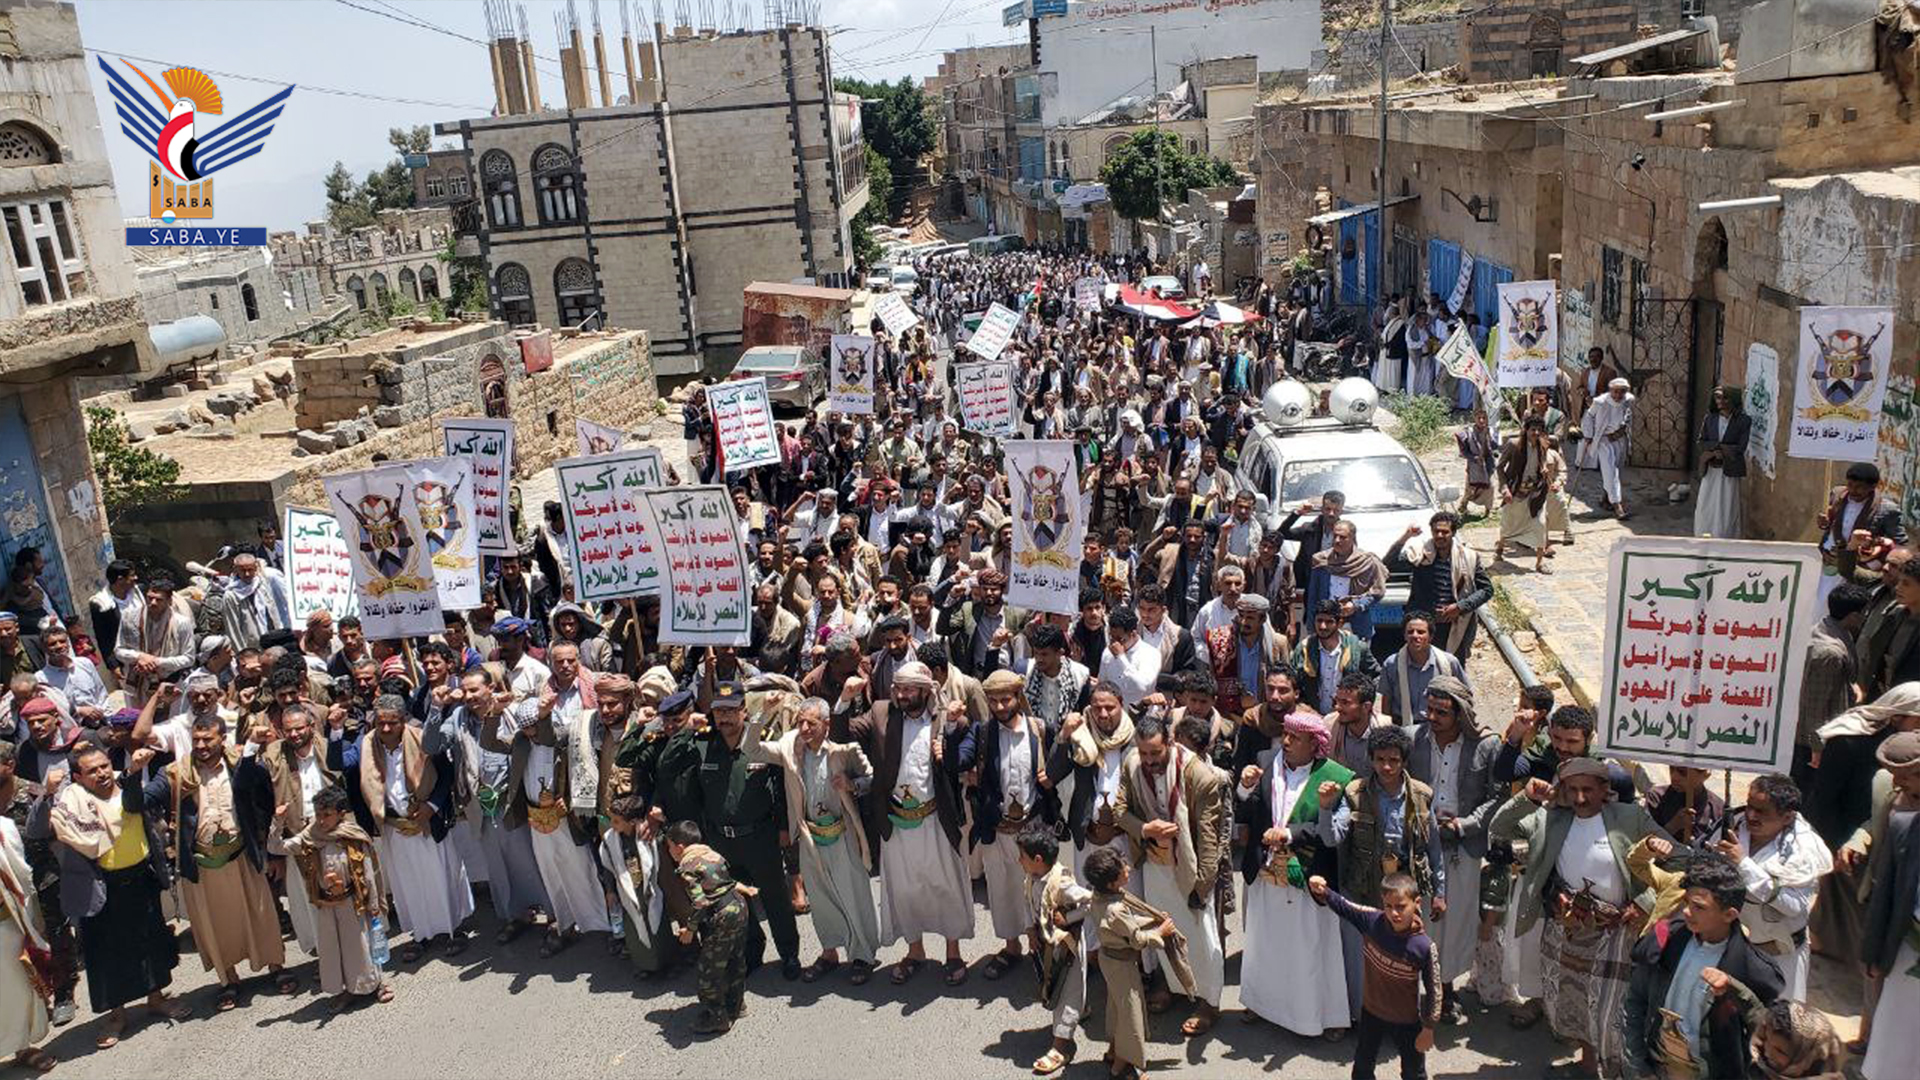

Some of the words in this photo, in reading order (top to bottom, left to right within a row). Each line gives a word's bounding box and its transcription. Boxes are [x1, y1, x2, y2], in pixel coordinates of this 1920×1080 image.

[451, 432, 480, 456] أكبر
[482, 437, 502, 455] الله
[571, 465, 617, 500] أكبر
[622, 465, 654, 487] الله
[660, 494, 694, 527] أكبر
[700, 497, 726, 519] الله
[293, 518, 333, 542] أكبر
[1629, 563, 1726, 608] أكبر
[1726, 570, 1789, 604] الله
[713, 598, 743, 625] النصر
[1627, 608, 1707, 637] لأمريكا
[1713, 618, 1781, 640] الموت
[1623, 643, 1703, 675] لإسرائيل
[1709, 652, 1777, 675] الموت
[1619, 679, 1675, 704] اليهود
[1681, 683, 1713, 708] على
[1721, 683, 1772, 708] اللعنة
[1616, 708, 1693, 747] للإسلام
[1698, 713, 1768, 748] النصر
